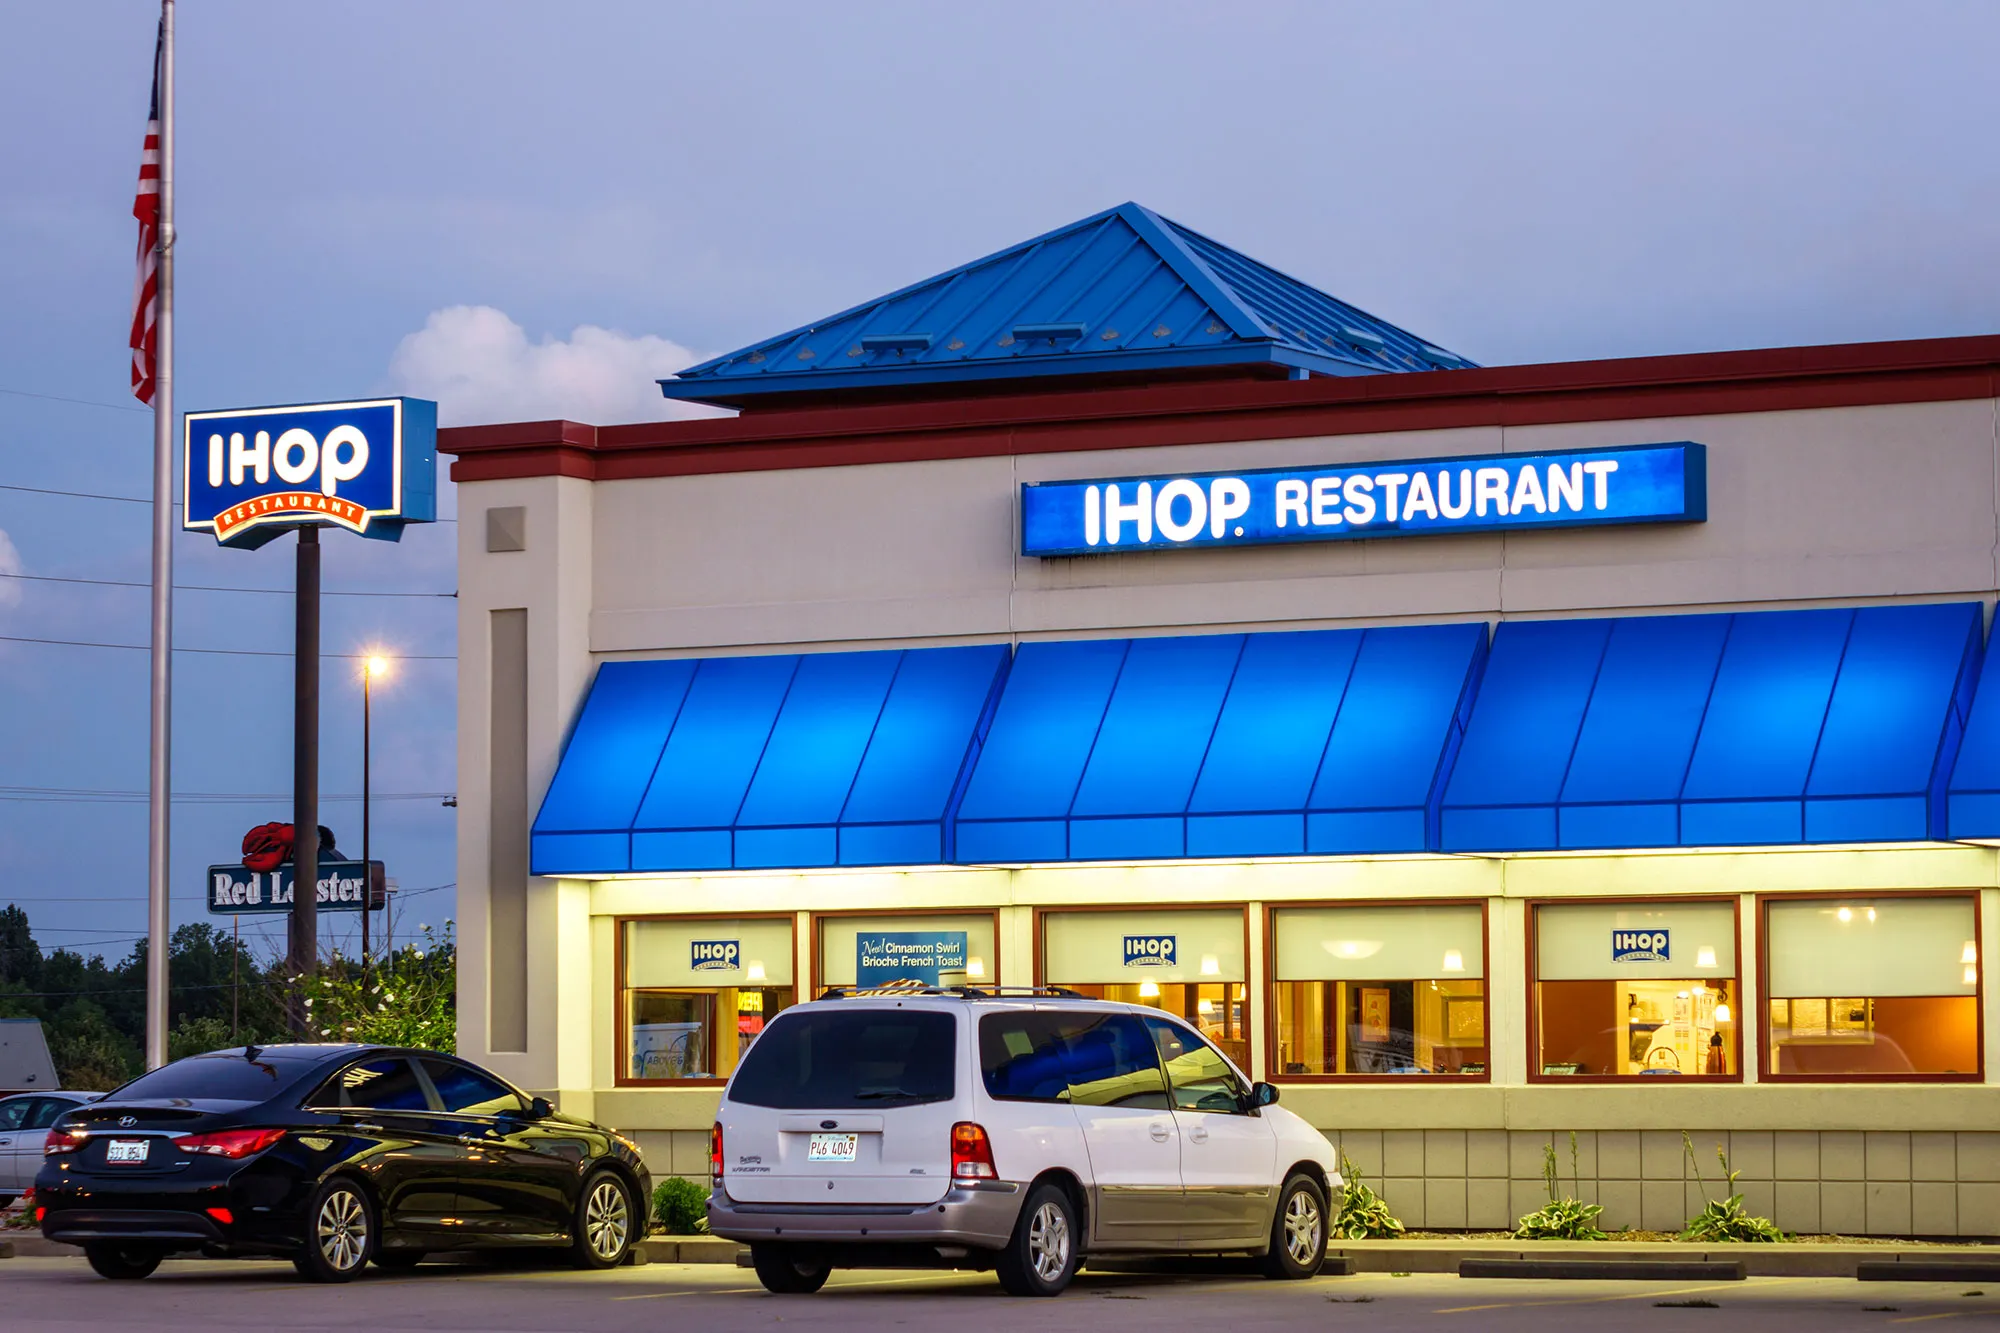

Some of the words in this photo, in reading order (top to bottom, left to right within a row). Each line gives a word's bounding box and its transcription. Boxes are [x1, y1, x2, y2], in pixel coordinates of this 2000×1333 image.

[208, 424, 369, 498] IHOP
[1276, 461, 1619, 527] RESTAURANT
[223, 495, 356, 525] RESTAURANT
[214, 872, 262, 906] Red
[694, 943, 737, 963] IHOP
[861, 937, 886, 956] New!
[885, 942, 934, 954] Cinnamon
[936, 941, 960, 954] Swirl
[1126, 938, 1174, 960] IHOP
[1616, 932, 1667, 954] IHOP
[862, 955, 899, 967] Brioche
[901, 955, 934, 967] French
[936, 955, 963, 966] Toast
[810, 1141, 828, 1156] P46
[831, 1141, 855, 1156] 4049
